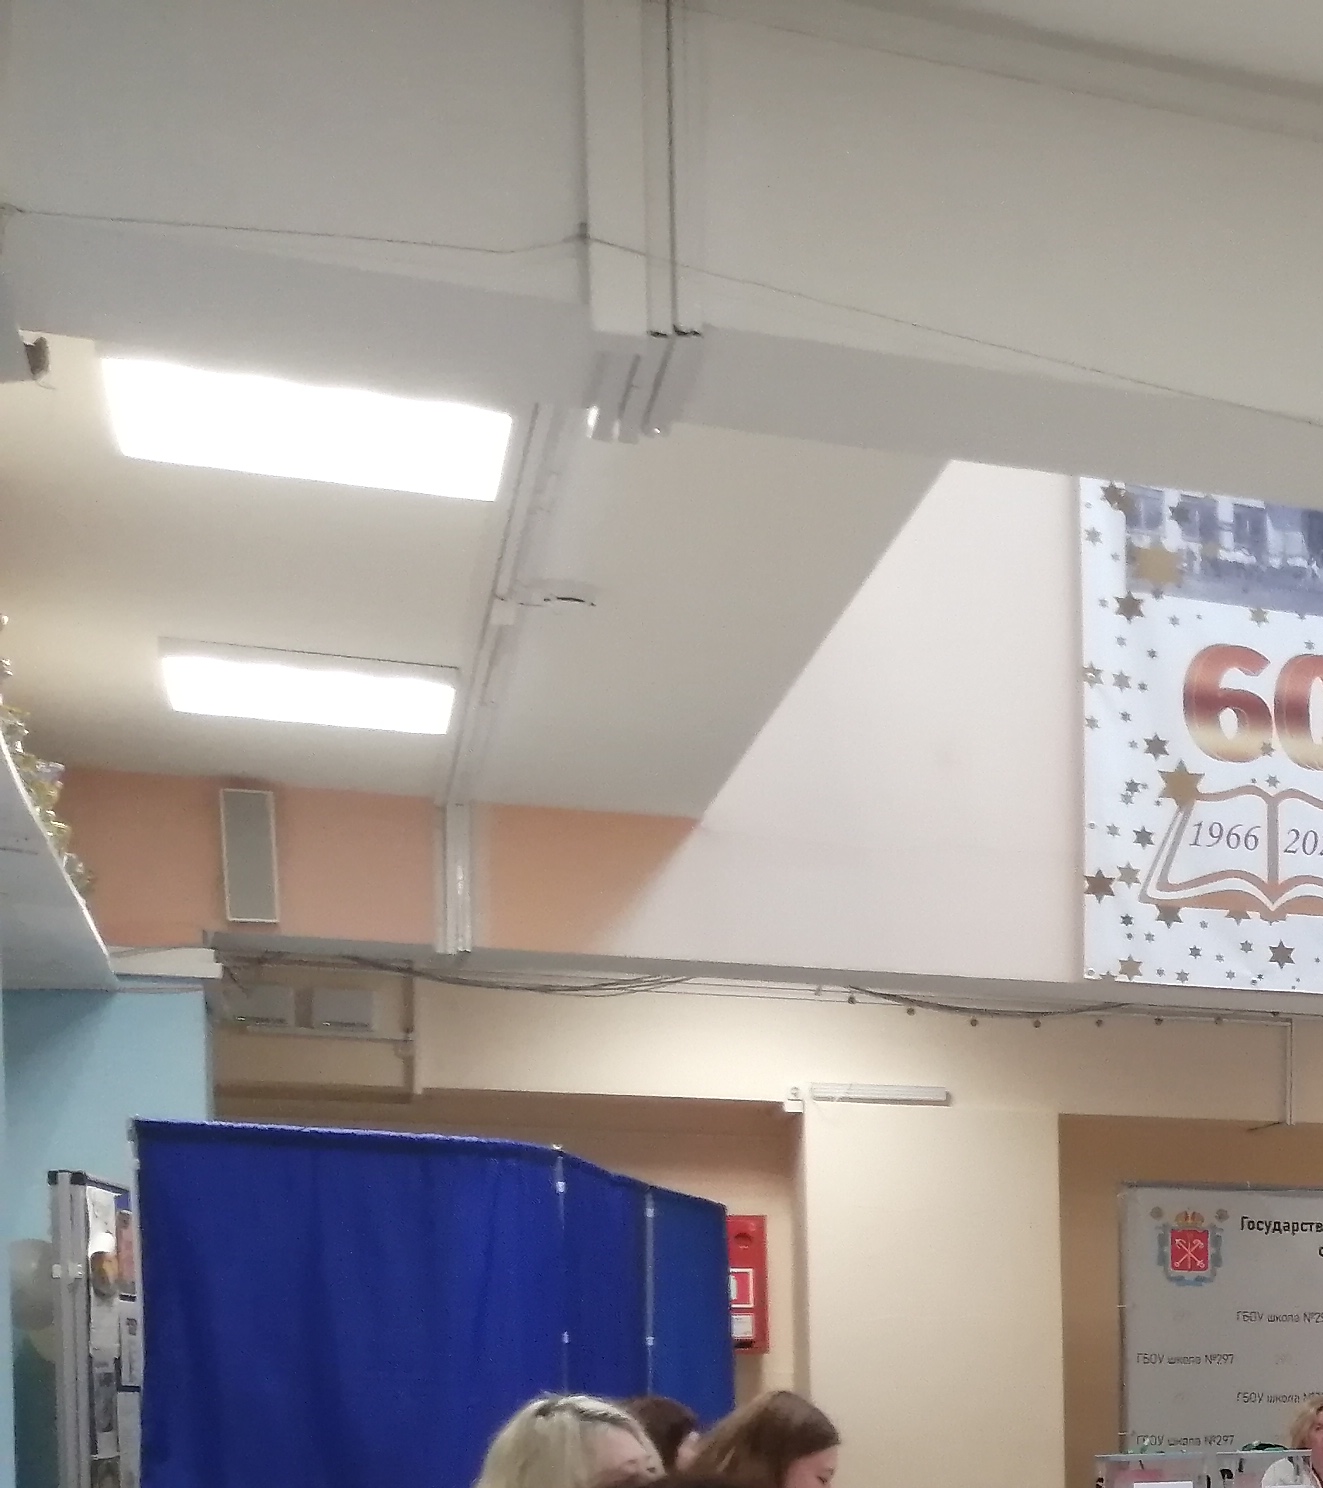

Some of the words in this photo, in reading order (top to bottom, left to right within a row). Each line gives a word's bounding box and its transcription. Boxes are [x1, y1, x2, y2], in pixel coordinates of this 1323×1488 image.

[1189, 821, 1261, 850] 1966
[1267, 1313, 1299, 1323] школа
[1204, 1353, 1234, 1365] №297
